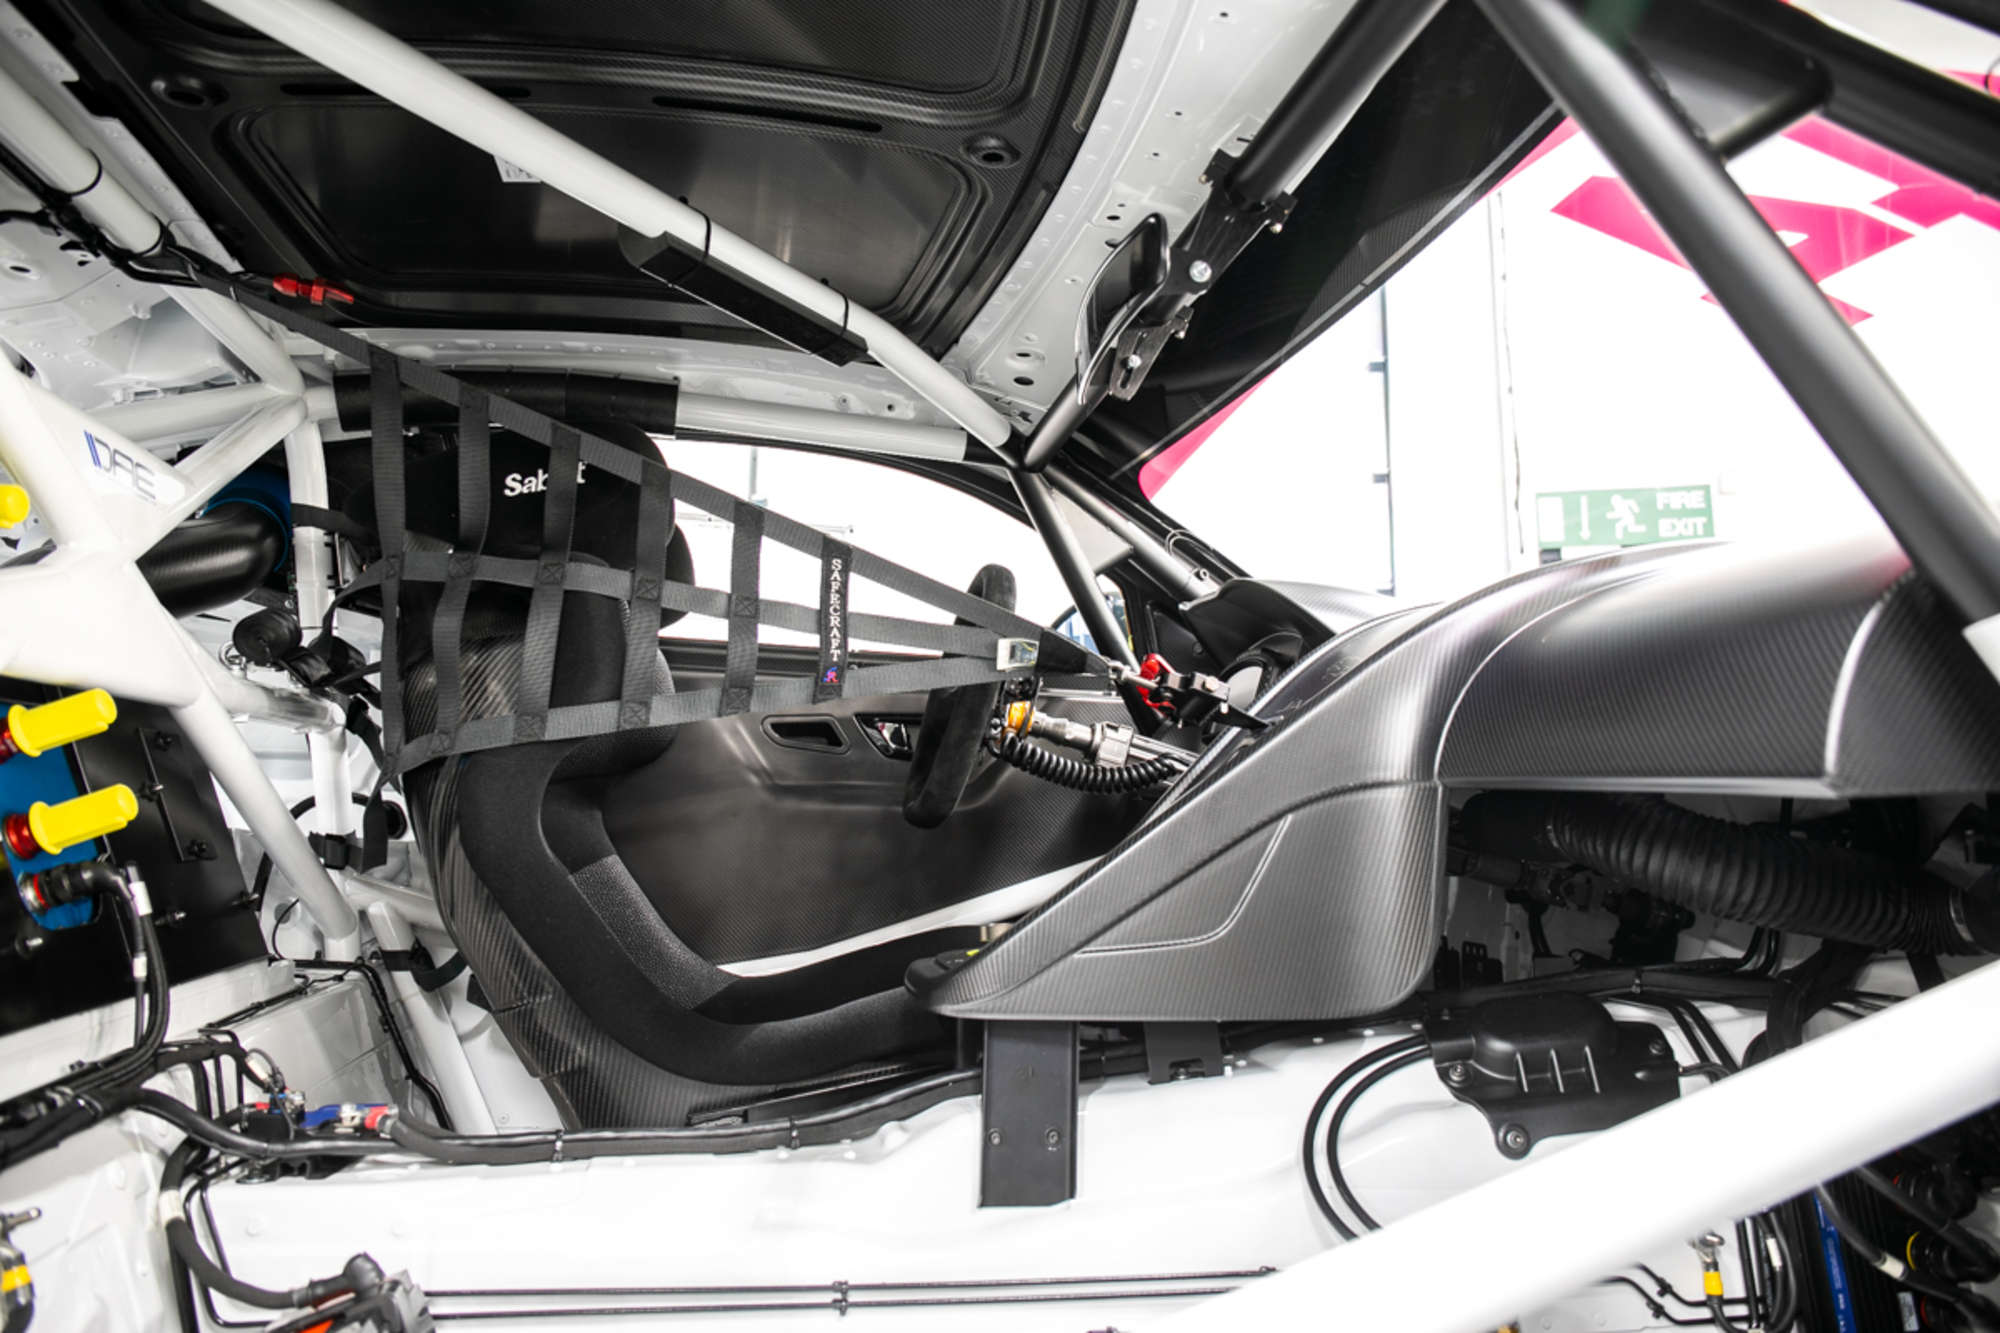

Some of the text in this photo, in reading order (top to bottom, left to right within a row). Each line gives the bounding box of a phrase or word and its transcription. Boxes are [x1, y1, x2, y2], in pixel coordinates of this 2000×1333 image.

[503, 461, 586, 497] Sabt
[1656, 489, 1706, 510] FIRE
[1658, 517, 1708, 537] EXIT
[829, 558, 842, 662] SAFECRAFT
